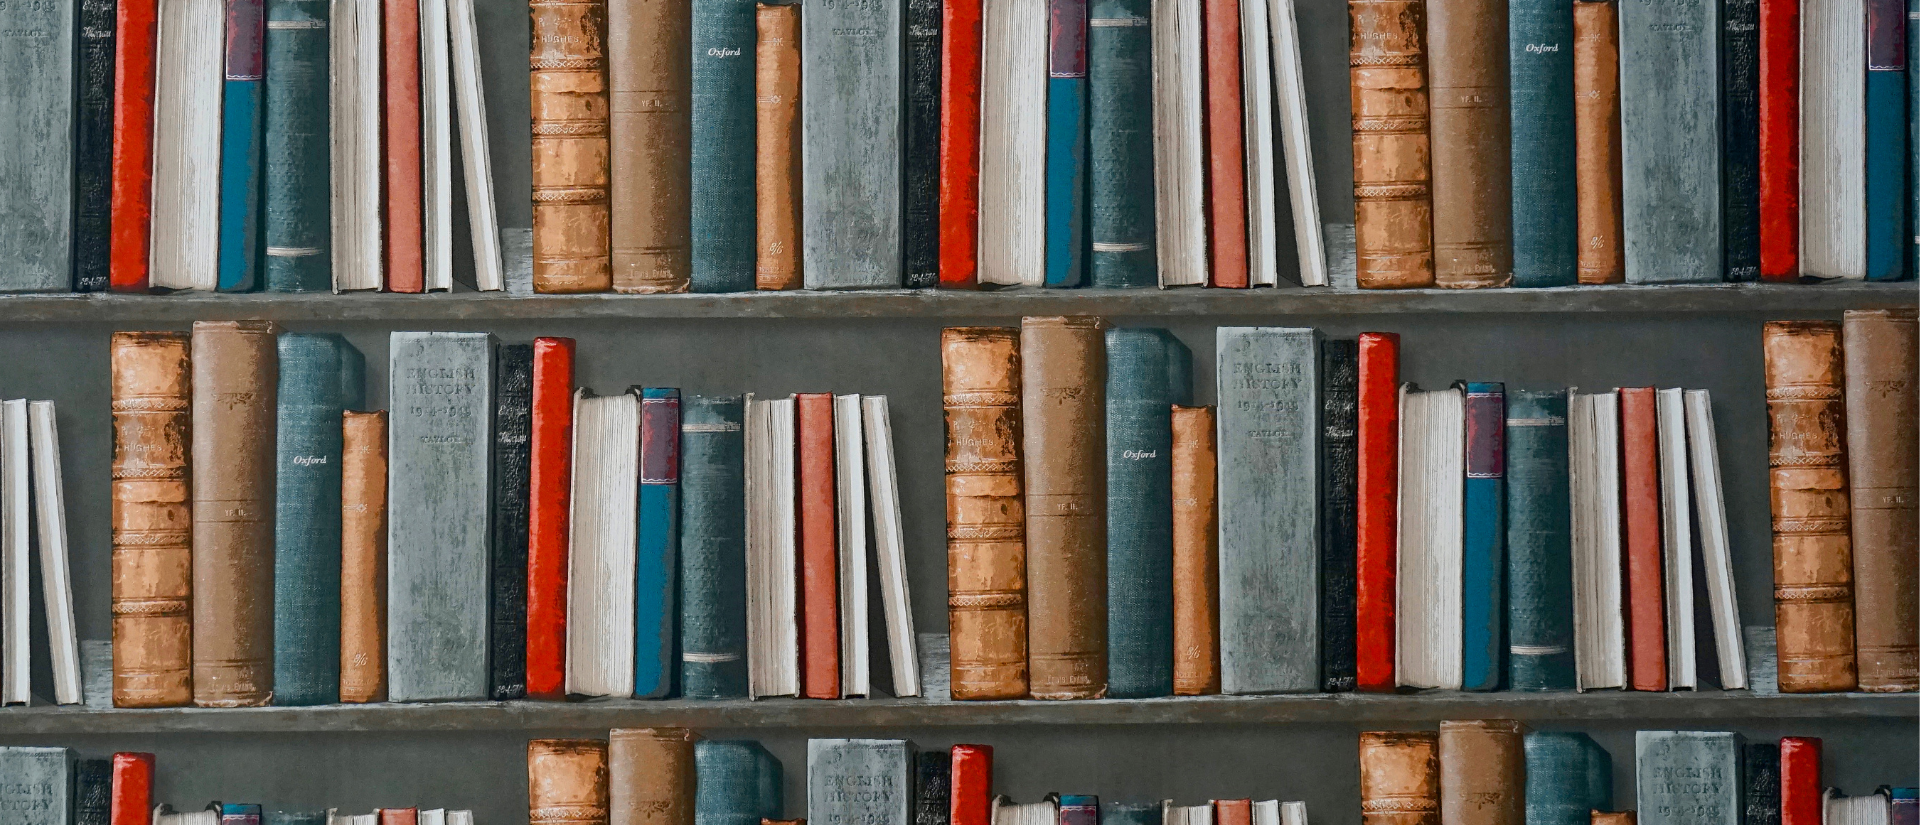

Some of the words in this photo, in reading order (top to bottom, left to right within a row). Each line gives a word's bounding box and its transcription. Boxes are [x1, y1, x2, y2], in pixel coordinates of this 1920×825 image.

[708, 47, 741, 58] Oxford
[1526, 43, 1559, 54] Oxford
[1590, 235, 1604, 249] 8/6
[769, 241, 784, 255] 8/6
[407, 368, 476, 379] ENGLISH
[1233, 362, 1301, 374] ENGLISH
[406, 383, 476, 395] HISTORY
[1233, 378, 1302, 390] HISTORY
[1123, 449, 1156, 460] Oxford
[293, 455, 327, 466] Oxford
[1186, 645, 1201, 660] 8/6
[353, 652, 368, 667] 8/6
[1653, 767, 1722, 779] ENGLISH
[824, 775, 893, 786] ENGLISH
[1653, 783, 1722, 794] HISTORY
[824, 791, 893, 802] HISTORY
